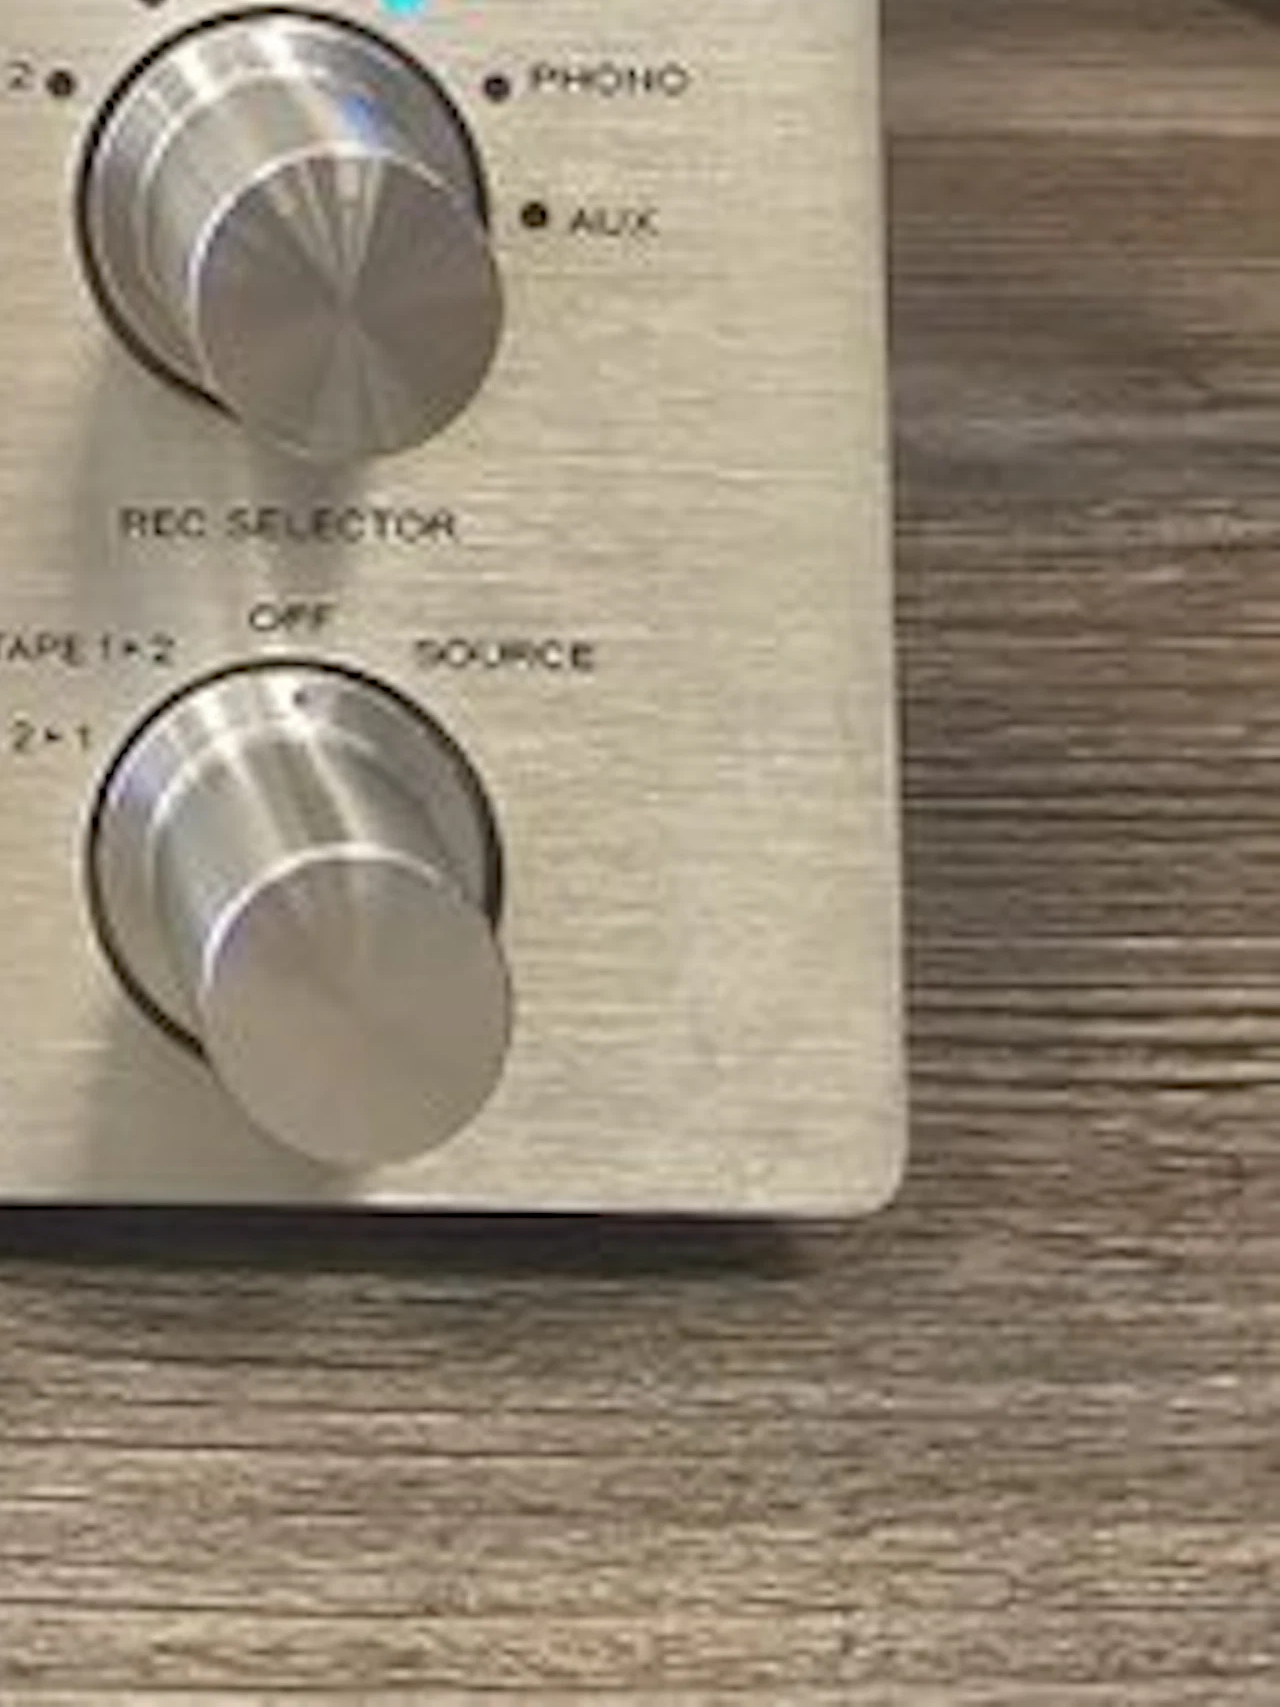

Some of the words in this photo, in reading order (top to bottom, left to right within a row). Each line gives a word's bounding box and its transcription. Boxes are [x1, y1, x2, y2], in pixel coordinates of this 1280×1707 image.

[10, 60, 33, 91] 2
[530, 64, 690, 95] PHONO
[567, 204, 658, 237] AUX
[120, 507, 206, 539] REC
[225, 507, 458, 541] SELECTOR
[250, 603, 338, 633] OFF
[414, 638, 596, 671] SOURCE
